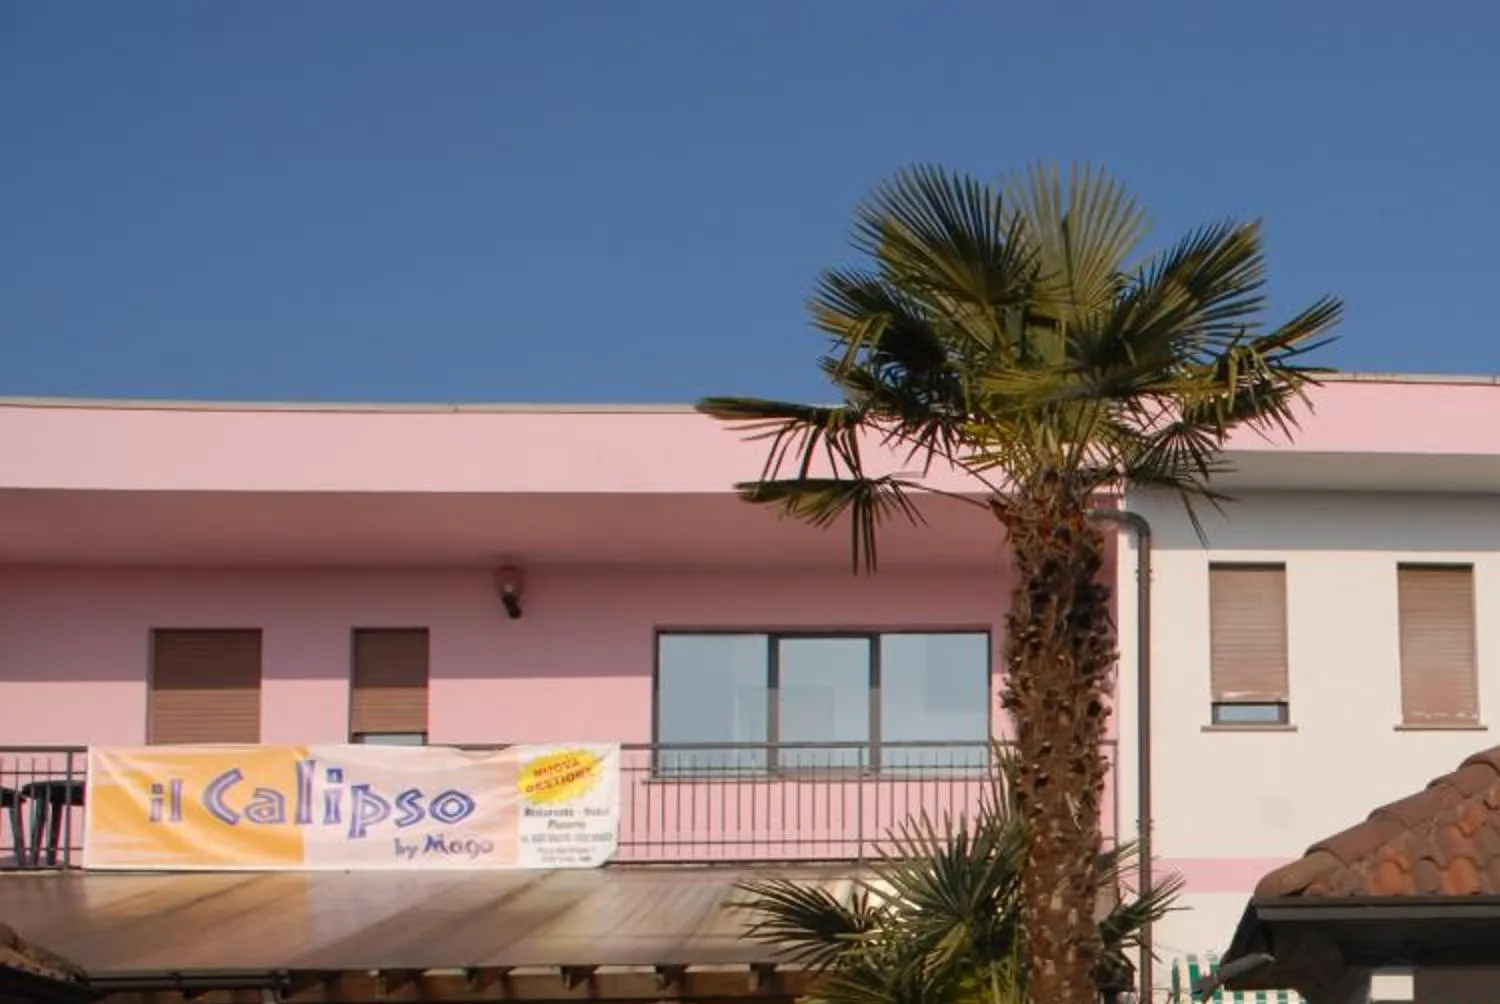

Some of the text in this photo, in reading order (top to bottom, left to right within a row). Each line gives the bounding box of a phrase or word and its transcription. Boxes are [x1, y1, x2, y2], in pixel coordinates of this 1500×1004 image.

[149, 760, 476, 839] il Calipso
[394, 838, 418, 859] by
